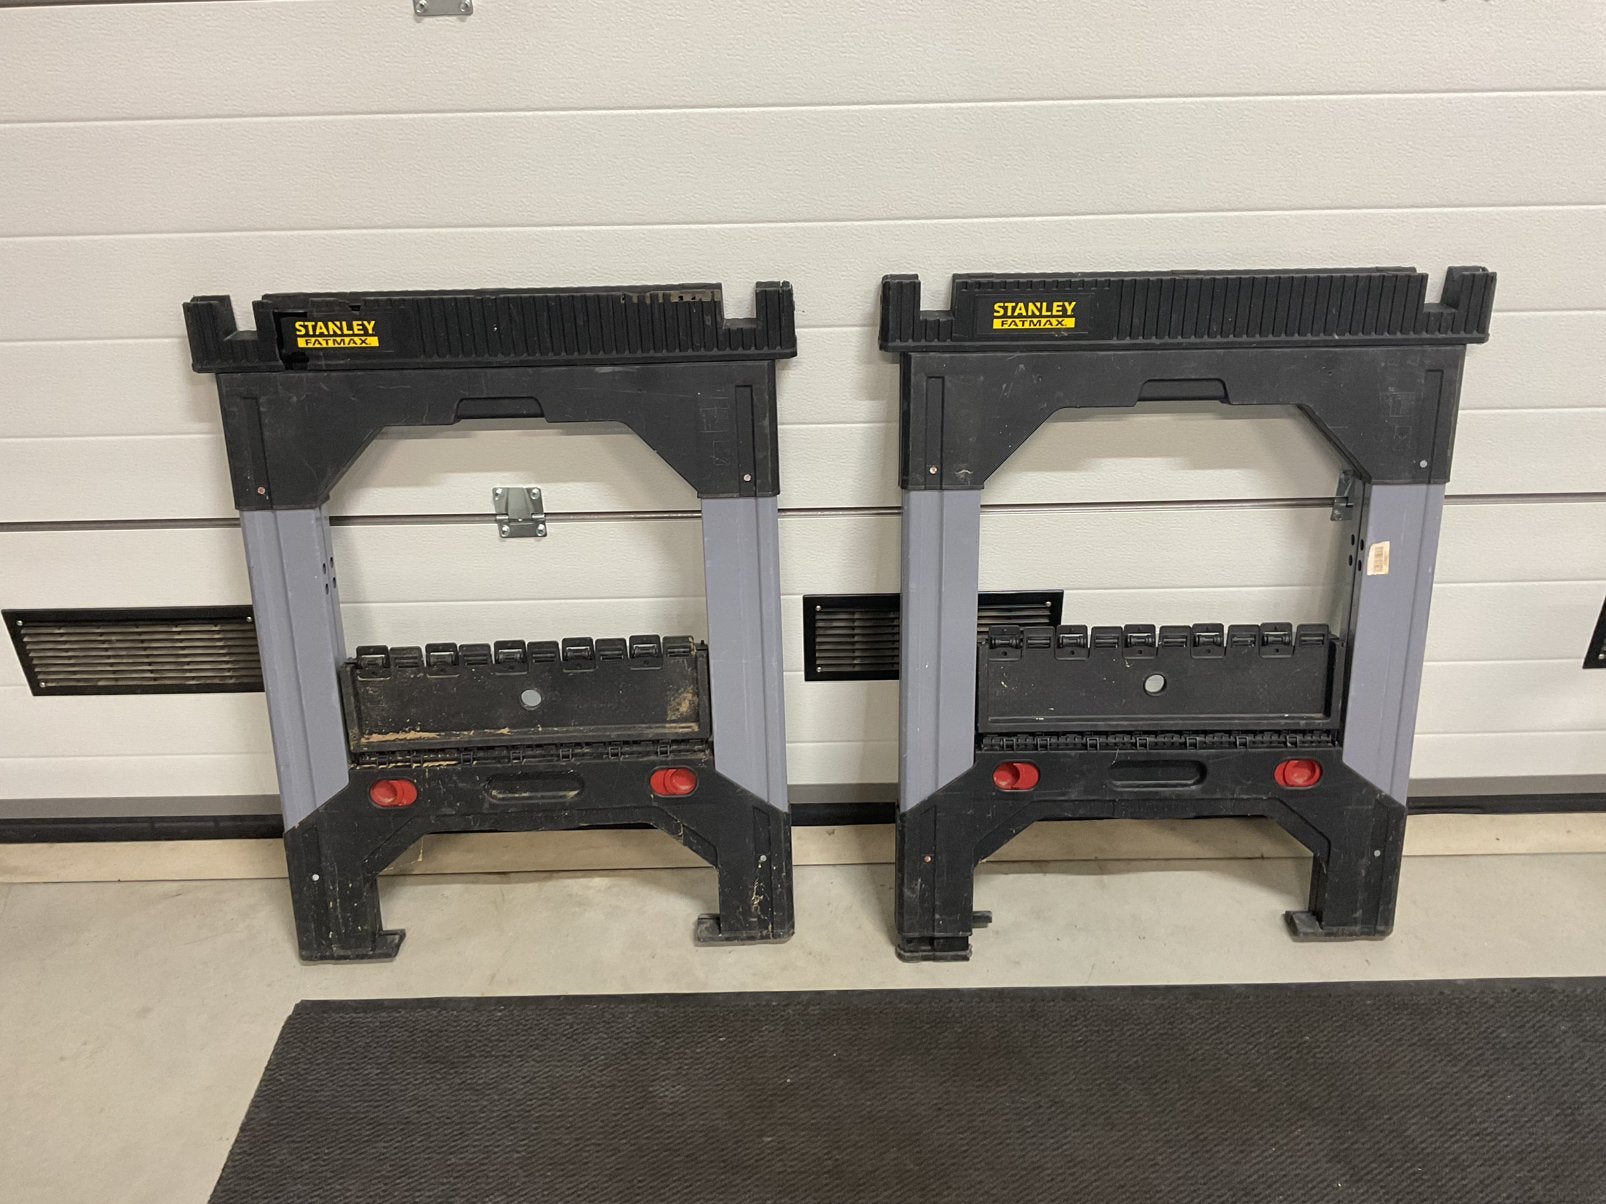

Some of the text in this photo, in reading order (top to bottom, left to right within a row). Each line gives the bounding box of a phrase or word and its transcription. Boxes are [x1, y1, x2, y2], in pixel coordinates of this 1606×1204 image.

[993, 302, 1076, 316] STANLEY
[295, 320, 376, 334] STANLEY
[1001, 319, 1065, 327] FATMAX
[305, 338, 368, 346] FATMAX
